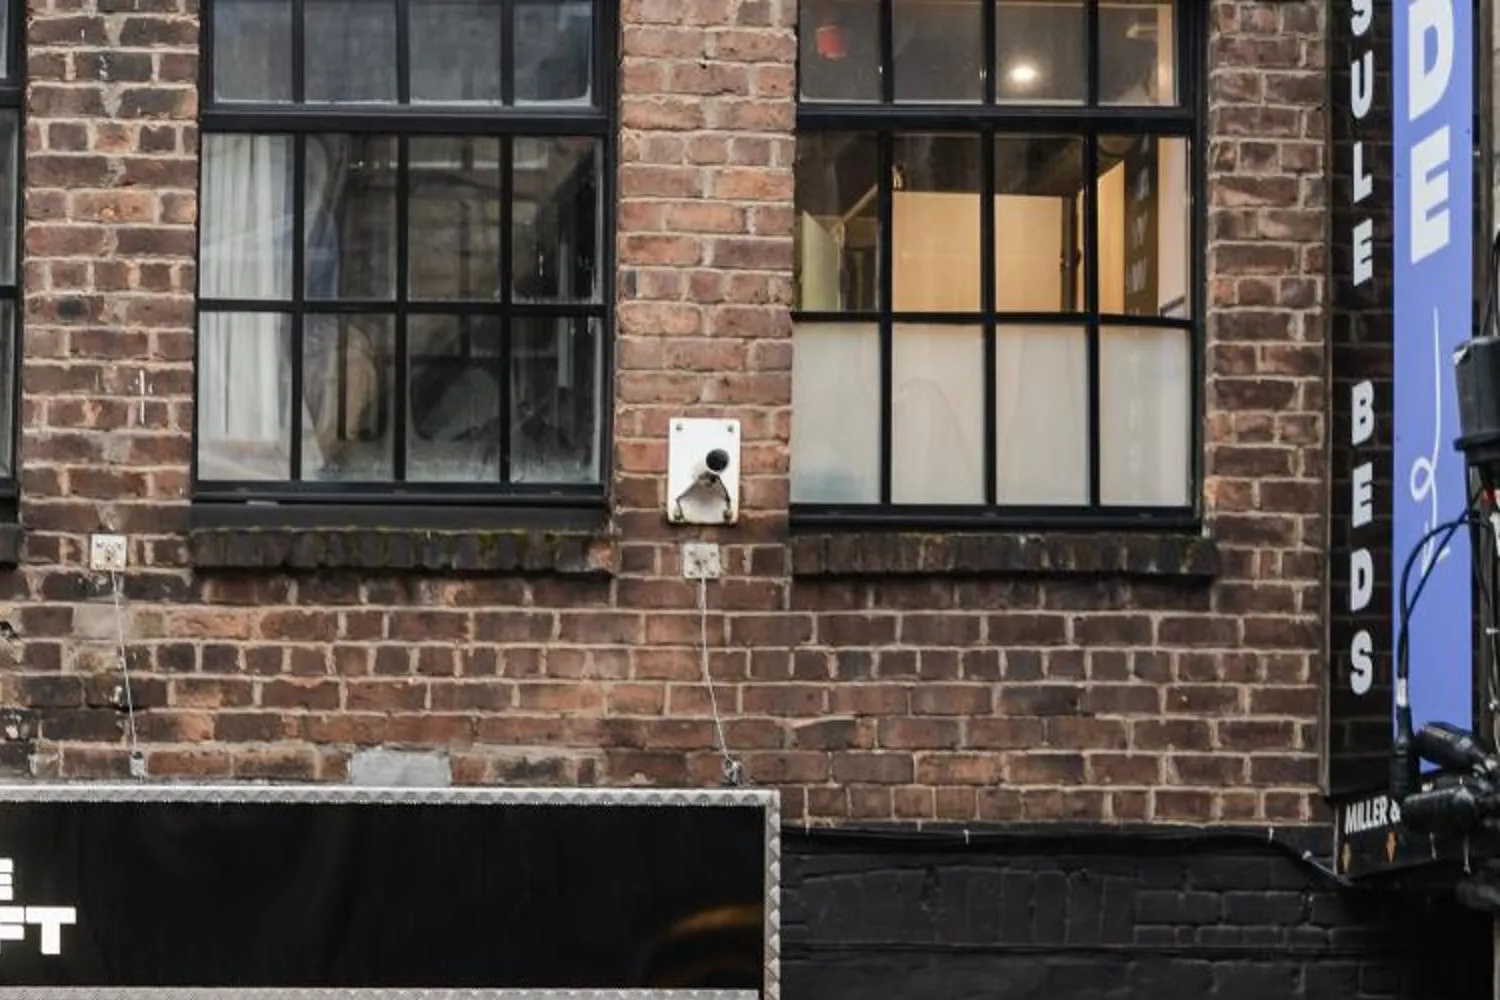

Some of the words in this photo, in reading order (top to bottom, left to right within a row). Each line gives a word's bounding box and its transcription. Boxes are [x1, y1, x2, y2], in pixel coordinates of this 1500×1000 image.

[1408, 0, 1454, 264] DE
[1351, 380, 1374, 694] BEDS
[1344, 796, 1388, 835] MILLER
